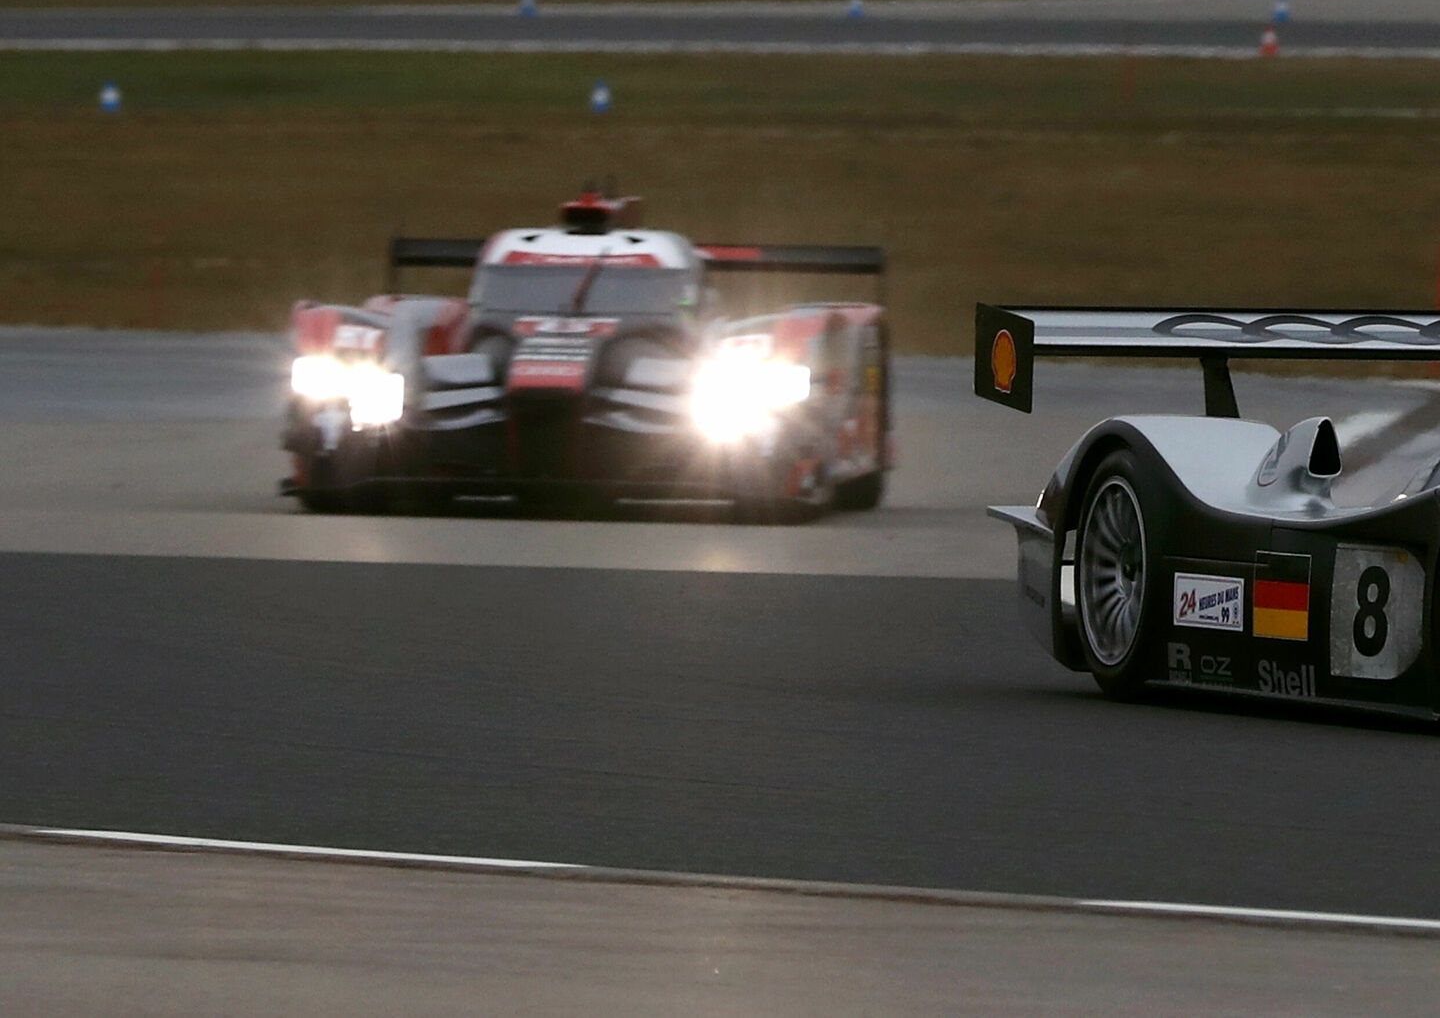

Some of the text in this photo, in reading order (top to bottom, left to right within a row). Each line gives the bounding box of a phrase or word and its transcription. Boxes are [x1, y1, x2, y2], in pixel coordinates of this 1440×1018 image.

[1179, 588, 1197, 618] 24
[1198, 586, 1239, 612] HEURES DU MANS
[1353, 565, 1391, 657] 8
[1221, 606, 1230, 623] 99
[1258, 658, 1317, 698] Shell
